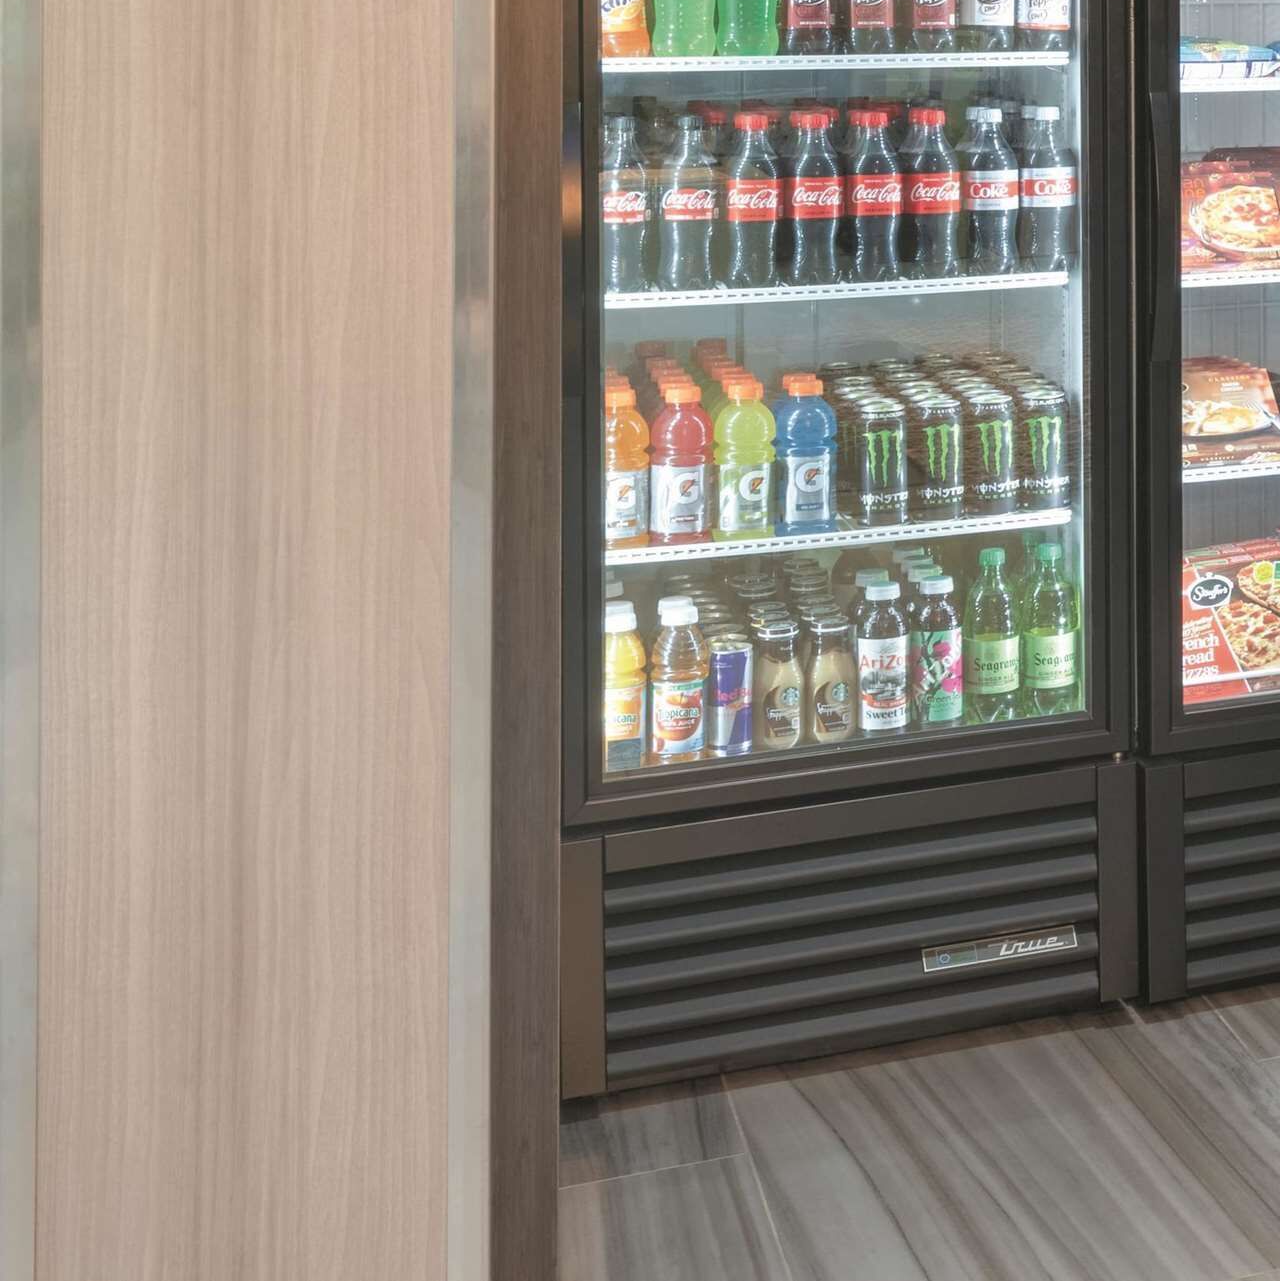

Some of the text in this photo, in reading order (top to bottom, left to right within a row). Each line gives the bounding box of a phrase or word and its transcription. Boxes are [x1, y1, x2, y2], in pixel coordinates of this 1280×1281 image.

[969, 182, 1009, 199] Coke
[1033, 179, 1072, 196] Coke
[661, 188, 718, 210] Coca-Cola
[859, 653, 906, 672] AriZo
[1183, 647, 1215, 665] read
[1183, 664, 1220, 679] izzas
[866, 706, 899, 720] Sweet
